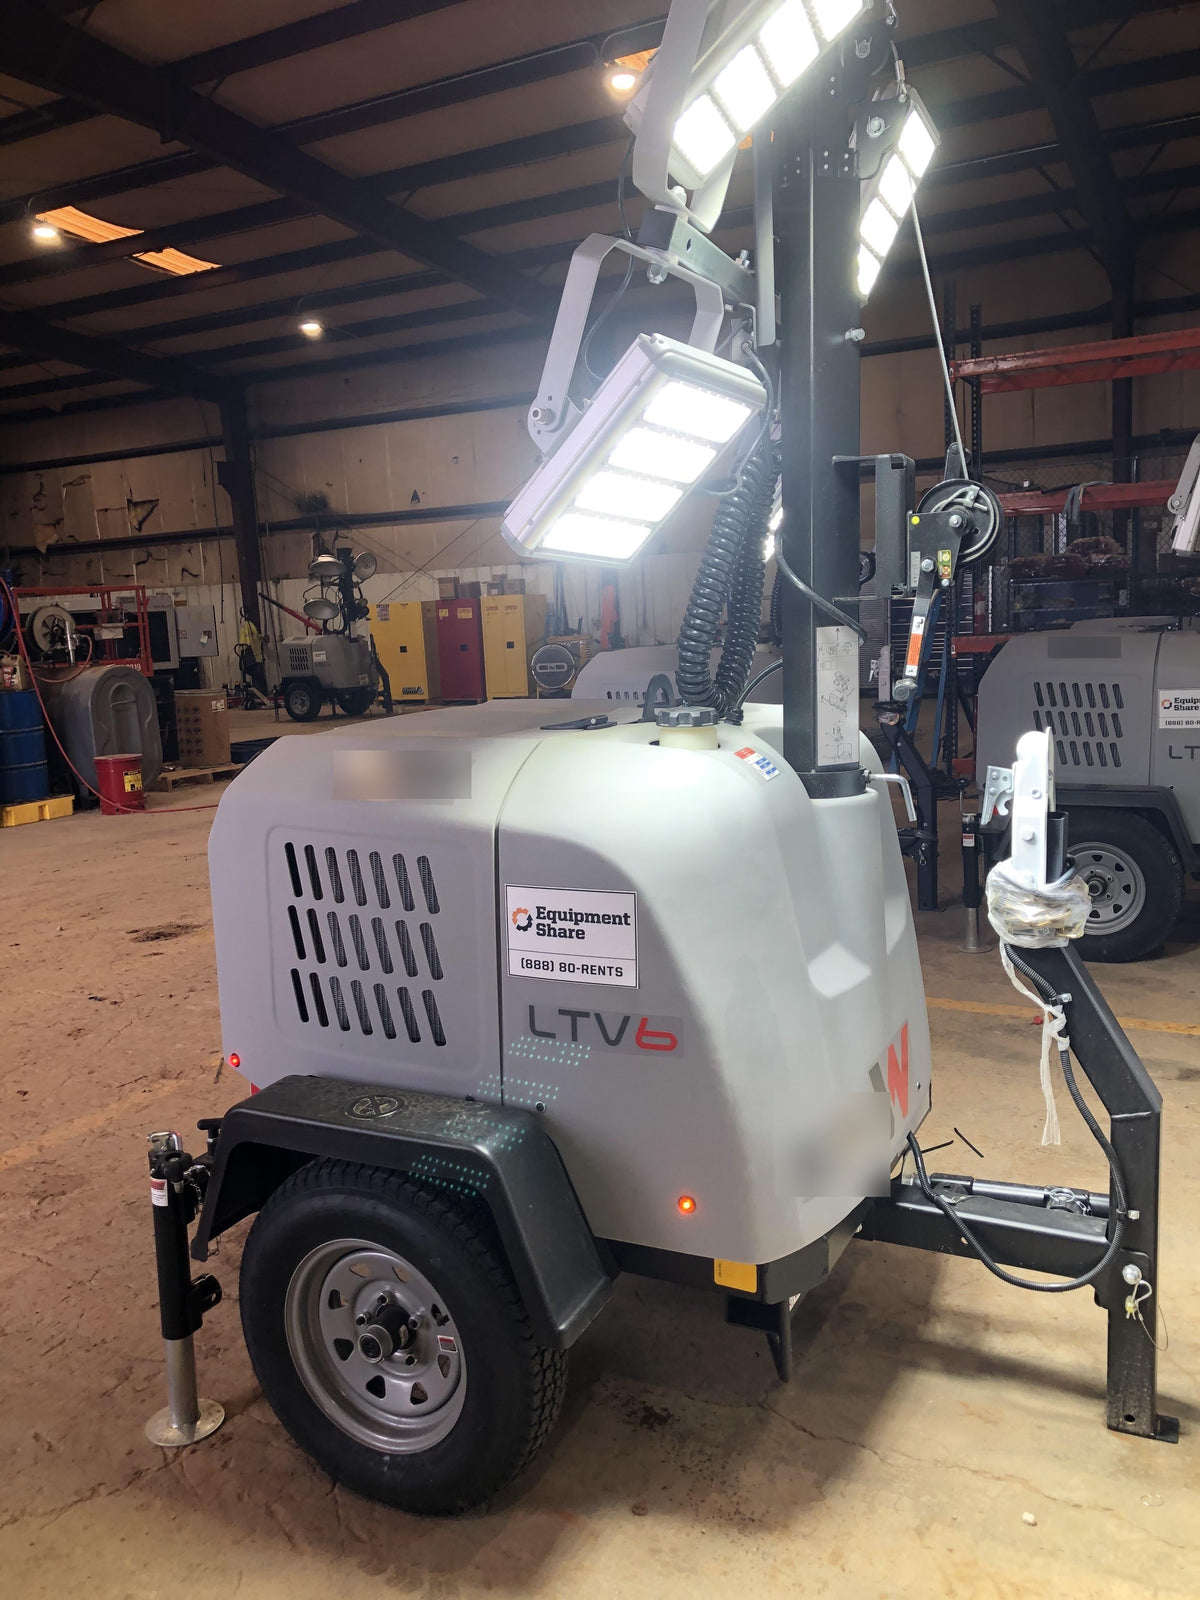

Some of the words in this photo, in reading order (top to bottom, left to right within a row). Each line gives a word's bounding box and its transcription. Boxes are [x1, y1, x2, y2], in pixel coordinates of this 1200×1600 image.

[1174, 697, 1200, 705] Equip
[535, 905, 631, 927] Equipment
[535, 922, 586, 940] Share
[520, 957, 555, 972] (888)
[558, 962, 624, 977] 80-RENTS
[528, 1004, 678, 1052] LTV6
